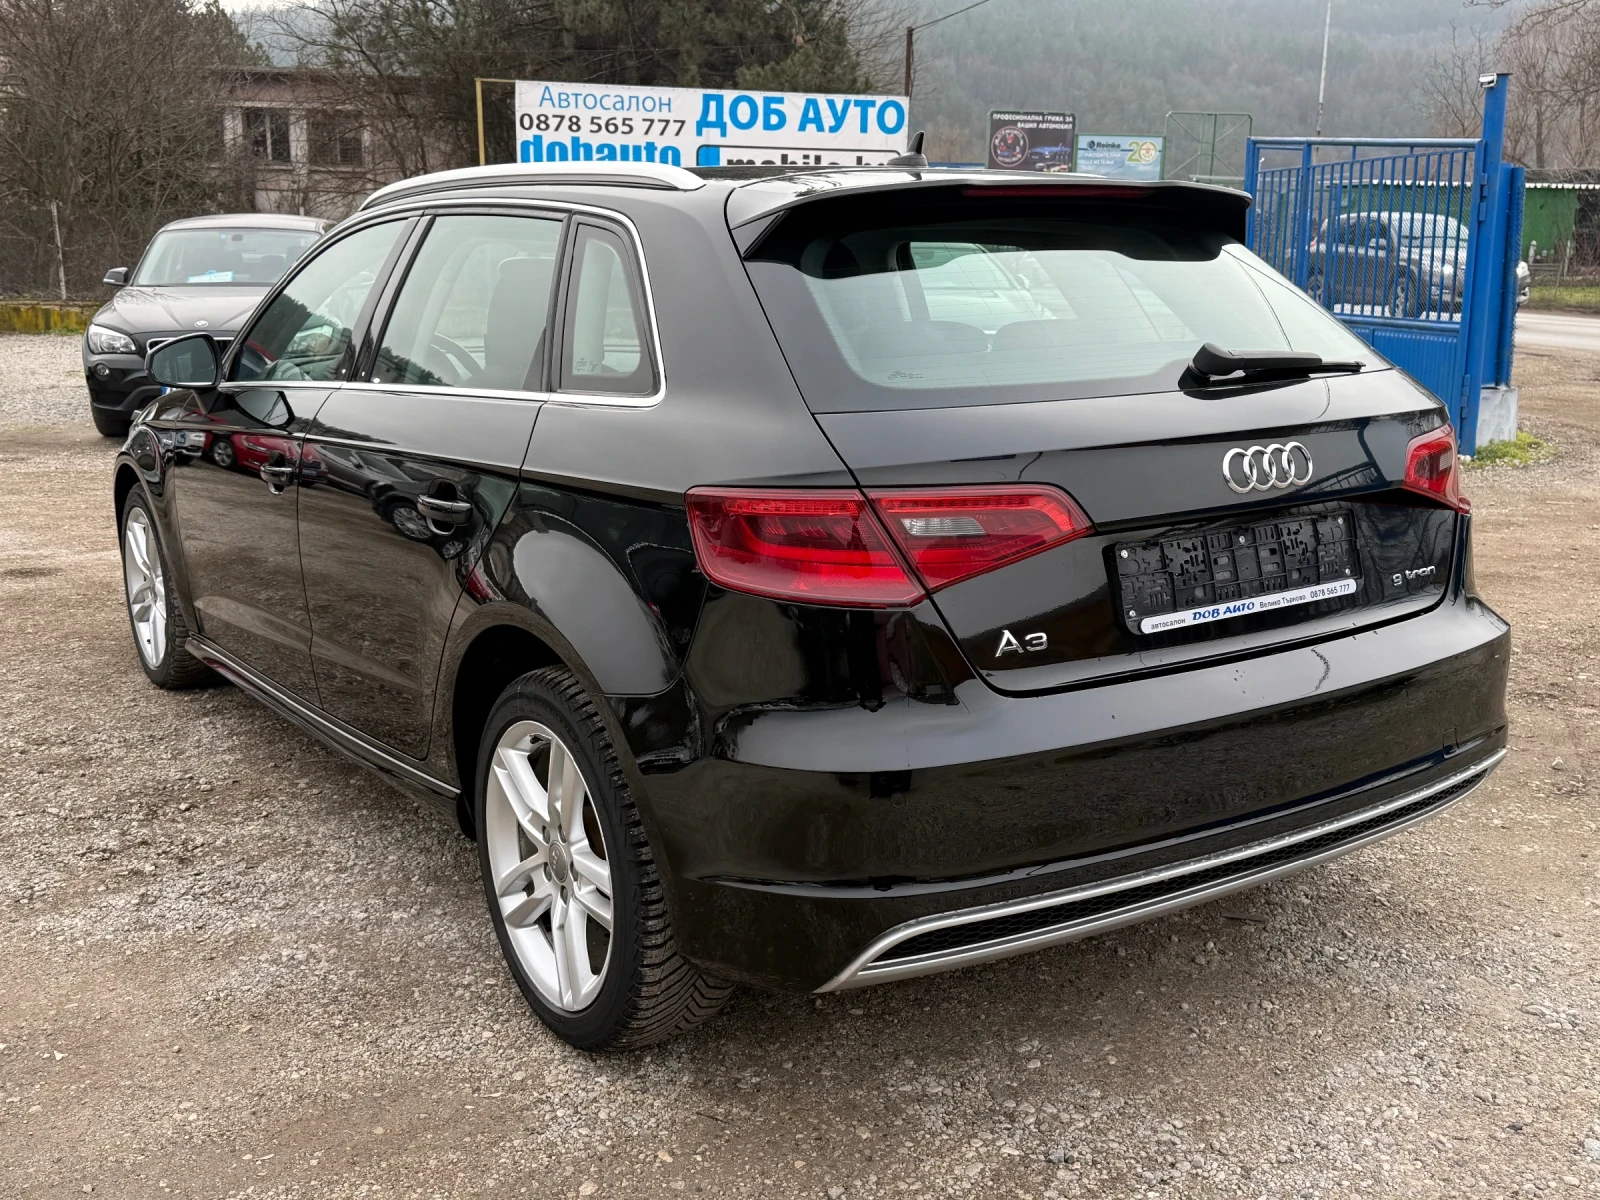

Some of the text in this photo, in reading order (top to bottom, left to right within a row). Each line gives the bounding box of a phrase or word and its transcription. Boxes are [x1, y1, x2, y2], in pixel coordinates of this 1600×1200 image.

[539, 86, 673, 114] Автосалон
[519, 112, 687, 137] 0878 565 777
[696, 93, 906, 138] ДОБ АУТО
[1096, 141, 1121, 150] Reinke
[1150, 618, 1186, 630] автосалон
[1192, 608, 1220, 621] DOB
[1259, 600, 1281, 609] Велико
[1281, 594, 1306, 606] Търново
[1310, 589, 1326, 599] 0878
[1326, 586, 1338, 596] 565
[1338, 583, 1350, 594] 777
[995, 629, 1048, 658] A3
